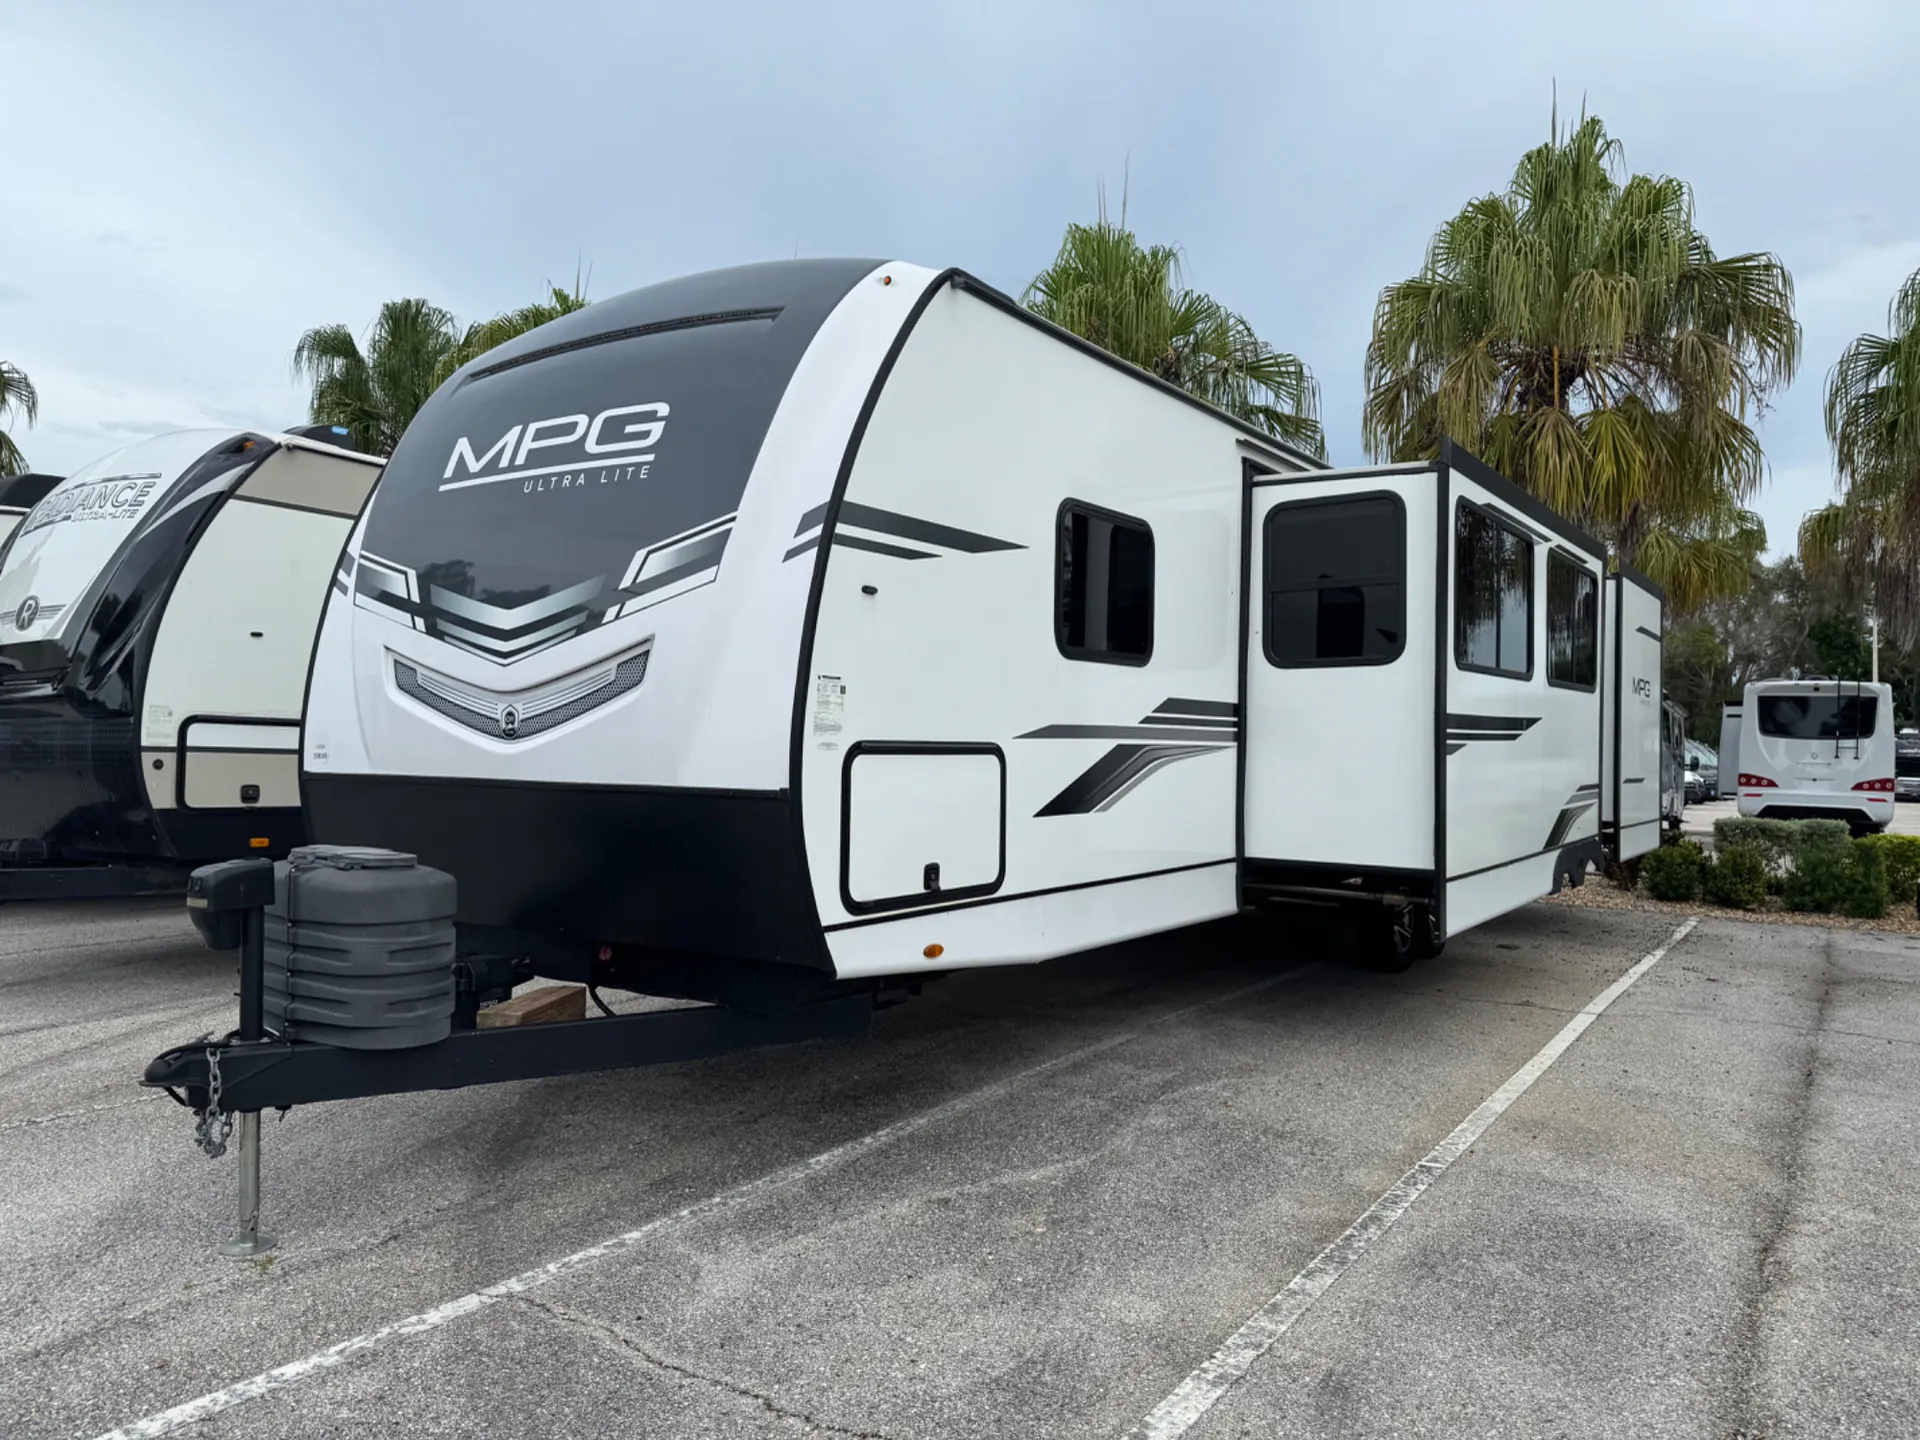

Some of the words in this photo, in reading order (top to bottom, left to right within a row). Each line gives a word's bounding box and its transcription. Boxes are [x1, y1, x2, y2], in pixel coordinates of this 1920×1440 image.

[443, 402, 670, 478] MPG
[523, 473, 585, 493] ULTRA
[601, 465, 650, 483] LITE
[23, 481, 156, 533] RADIANCE
